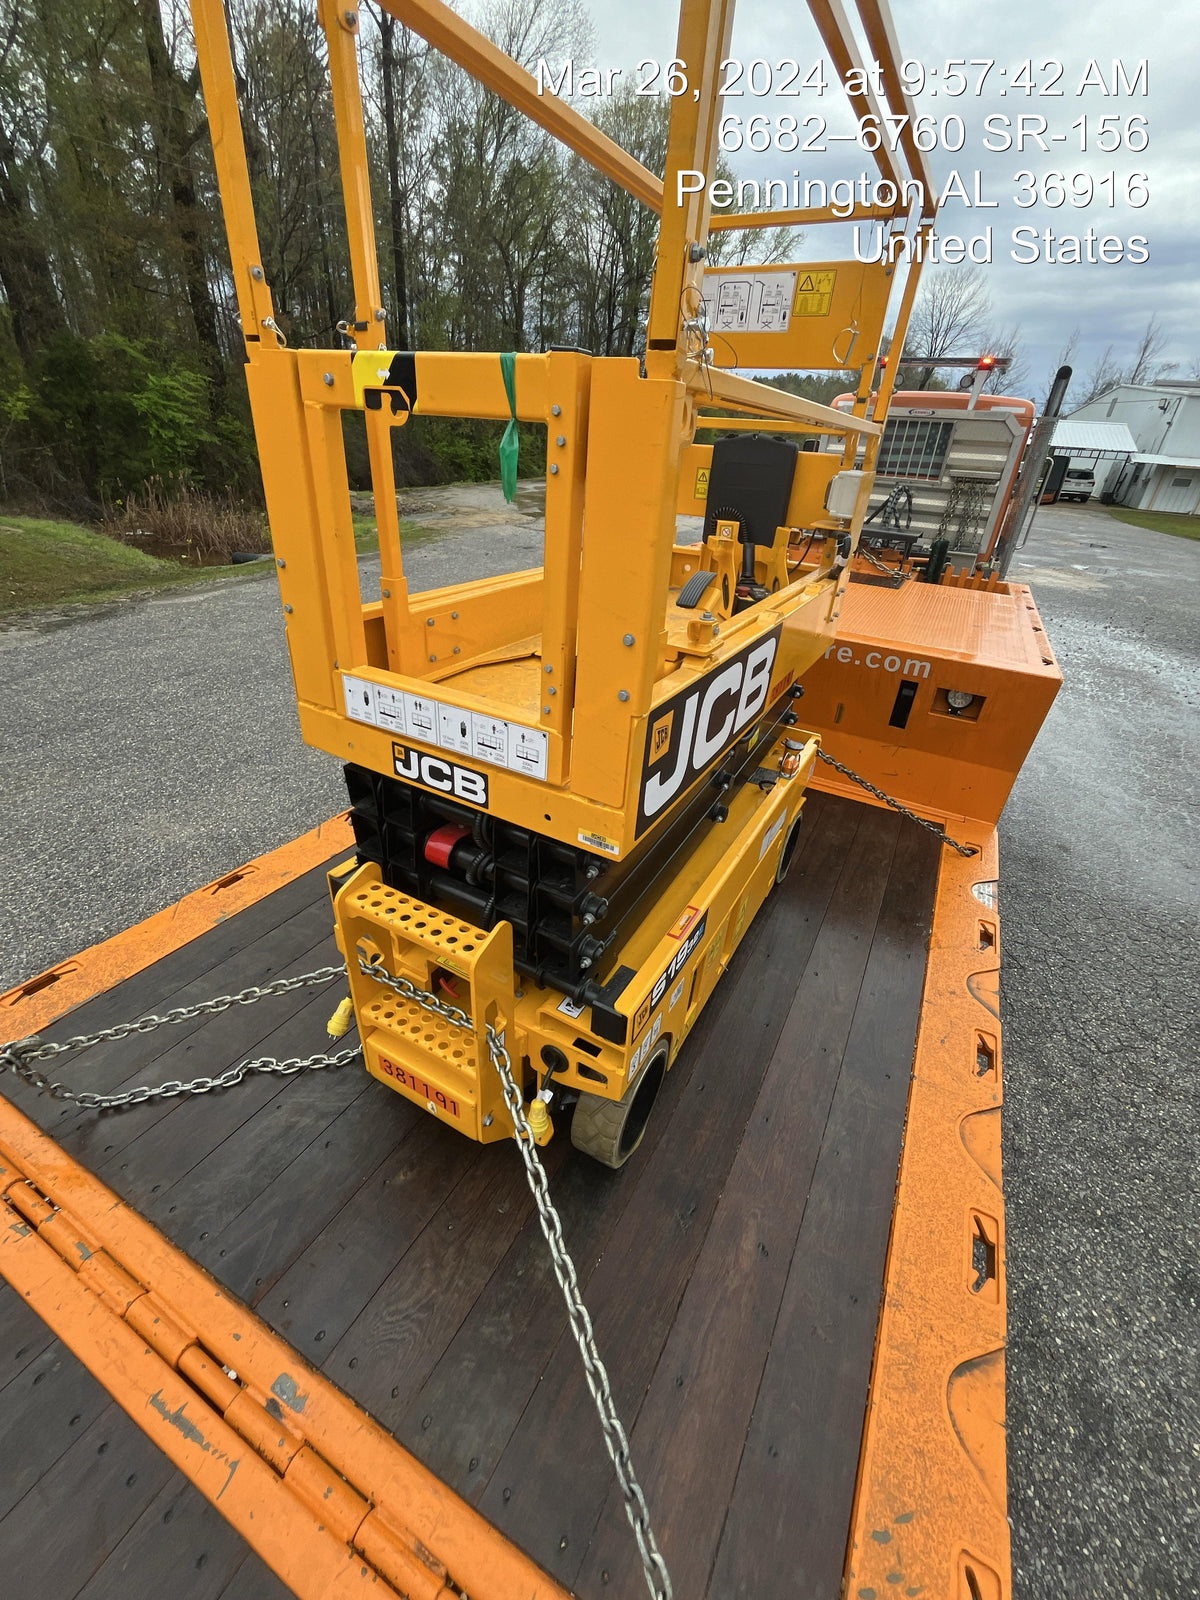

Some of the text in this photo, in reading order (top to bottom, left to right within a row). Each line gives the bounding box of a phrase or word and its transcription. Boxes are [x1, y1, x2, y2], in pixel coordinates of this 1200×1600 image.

[643, 637, 777, 817] JCB
[655, 726, 669, 750] JCB
[395, 750, 487, 805] JCB
[383, 1059, 457, 1116] 381191
